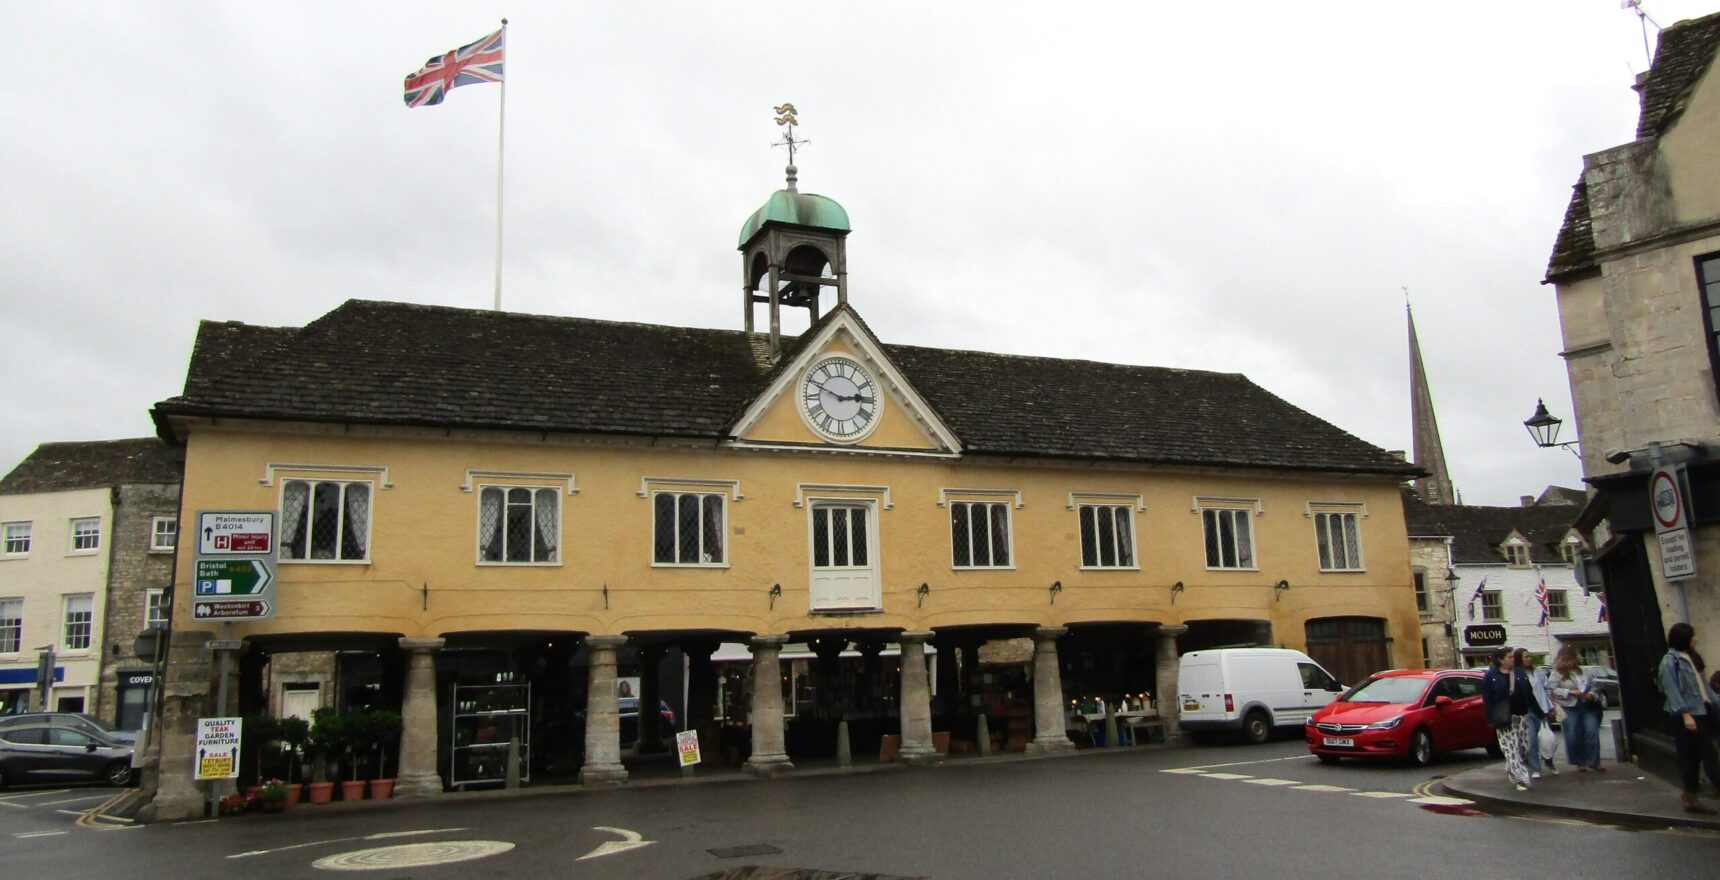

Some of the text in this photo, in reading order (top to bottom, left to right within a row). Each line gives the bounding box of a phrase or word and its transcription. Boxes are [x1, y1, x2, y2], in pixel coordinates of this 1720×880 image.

[1660, 536, 1677, 544] Except
[1666, 545, 1684, 553] loading
[1674, 552, 1690, 562] permit
[202, 581, 212, 592] P
[1470, 631, 1502, 639] MOLOH
[679, 743, 698, 752] SALE
